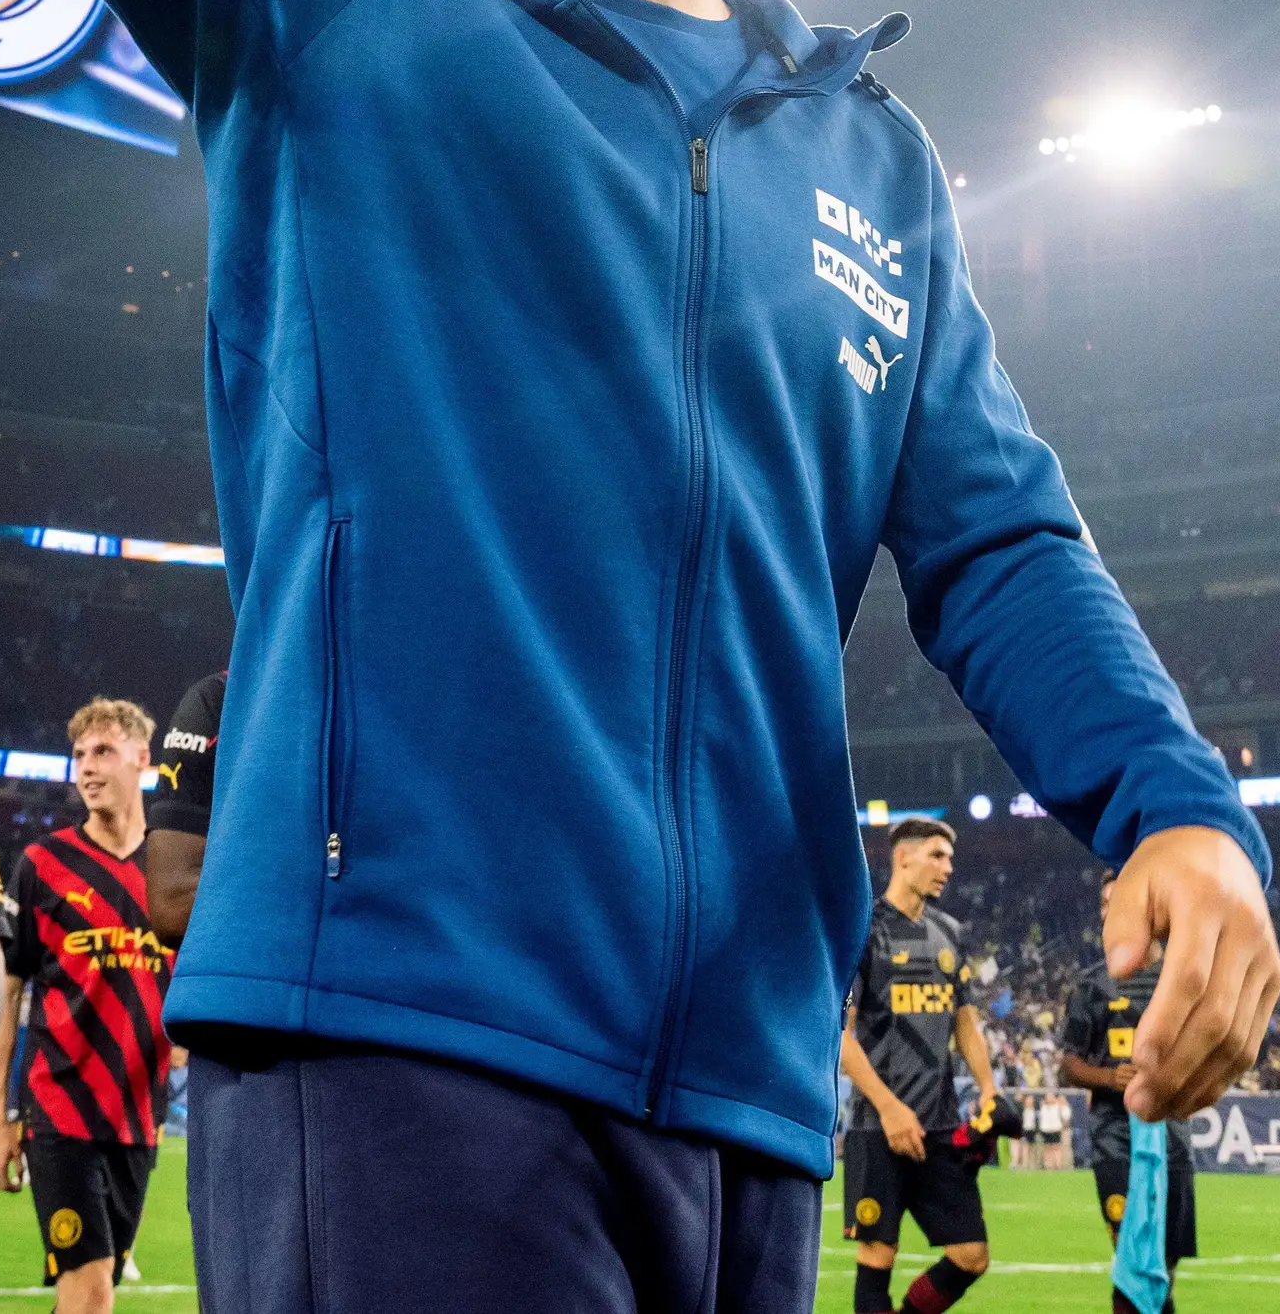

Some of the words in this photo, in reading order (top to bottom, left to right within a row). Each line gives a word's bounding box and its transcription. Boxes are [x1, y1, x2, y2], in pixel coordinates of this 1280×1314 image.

[815, 188, 902, 277] OKX
[818, 249, 860, 293] MAN
[864, 284, 904, 326] CITY
[838, 336, 878, 395] PUMA
[890, 983, 954, 1014] OKX
